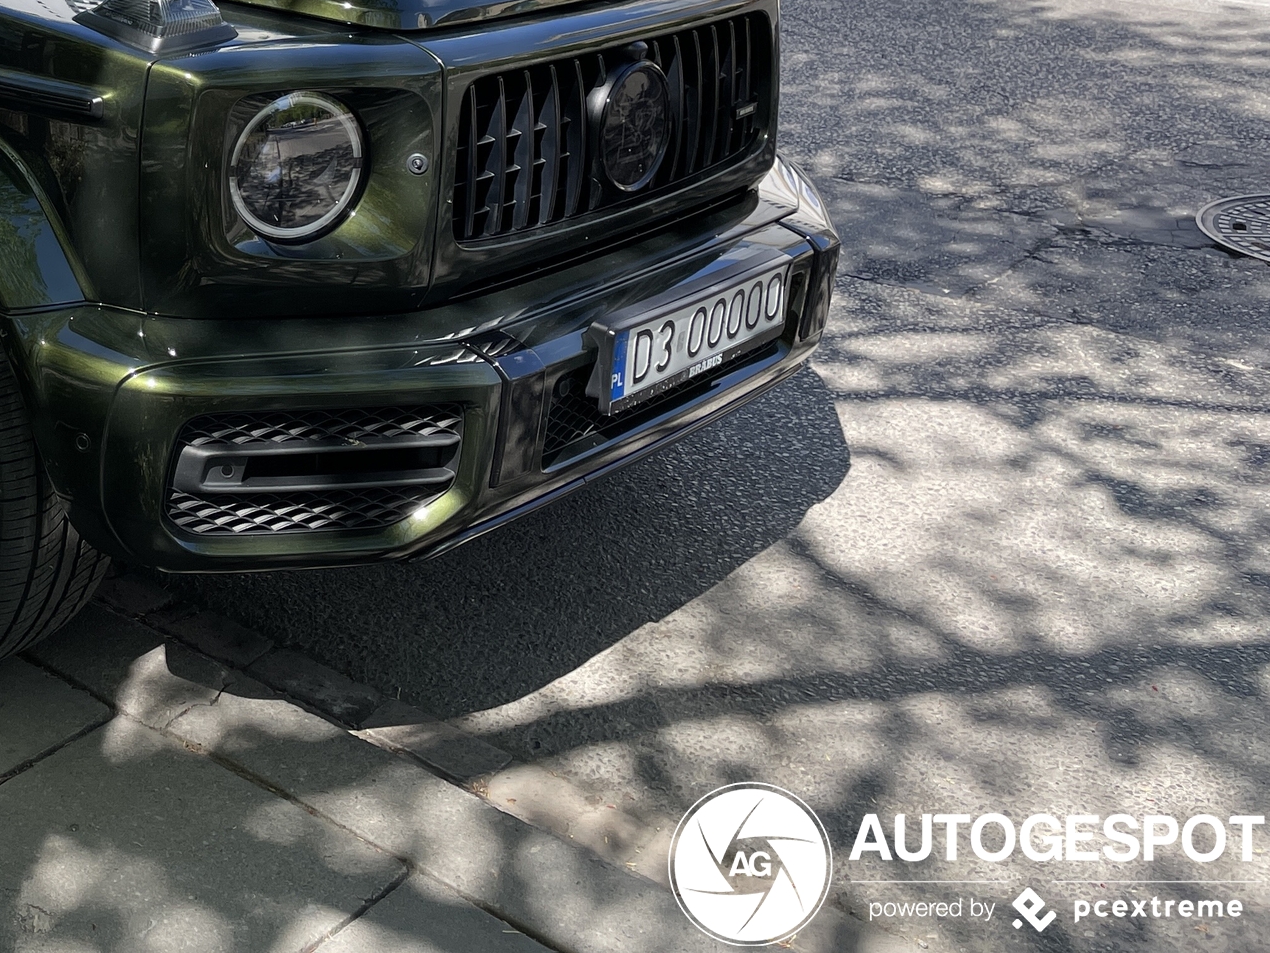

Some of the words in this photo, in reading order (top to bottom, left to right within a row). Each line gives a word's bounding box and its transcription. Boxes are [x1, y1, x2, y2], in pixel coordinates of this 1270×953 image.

[632, 319, 676, 385] D3
[687, 273, 783, 358] 00000
[689, 353, 723, 378] BRABUS
[610, 372, 623, 389] PL
